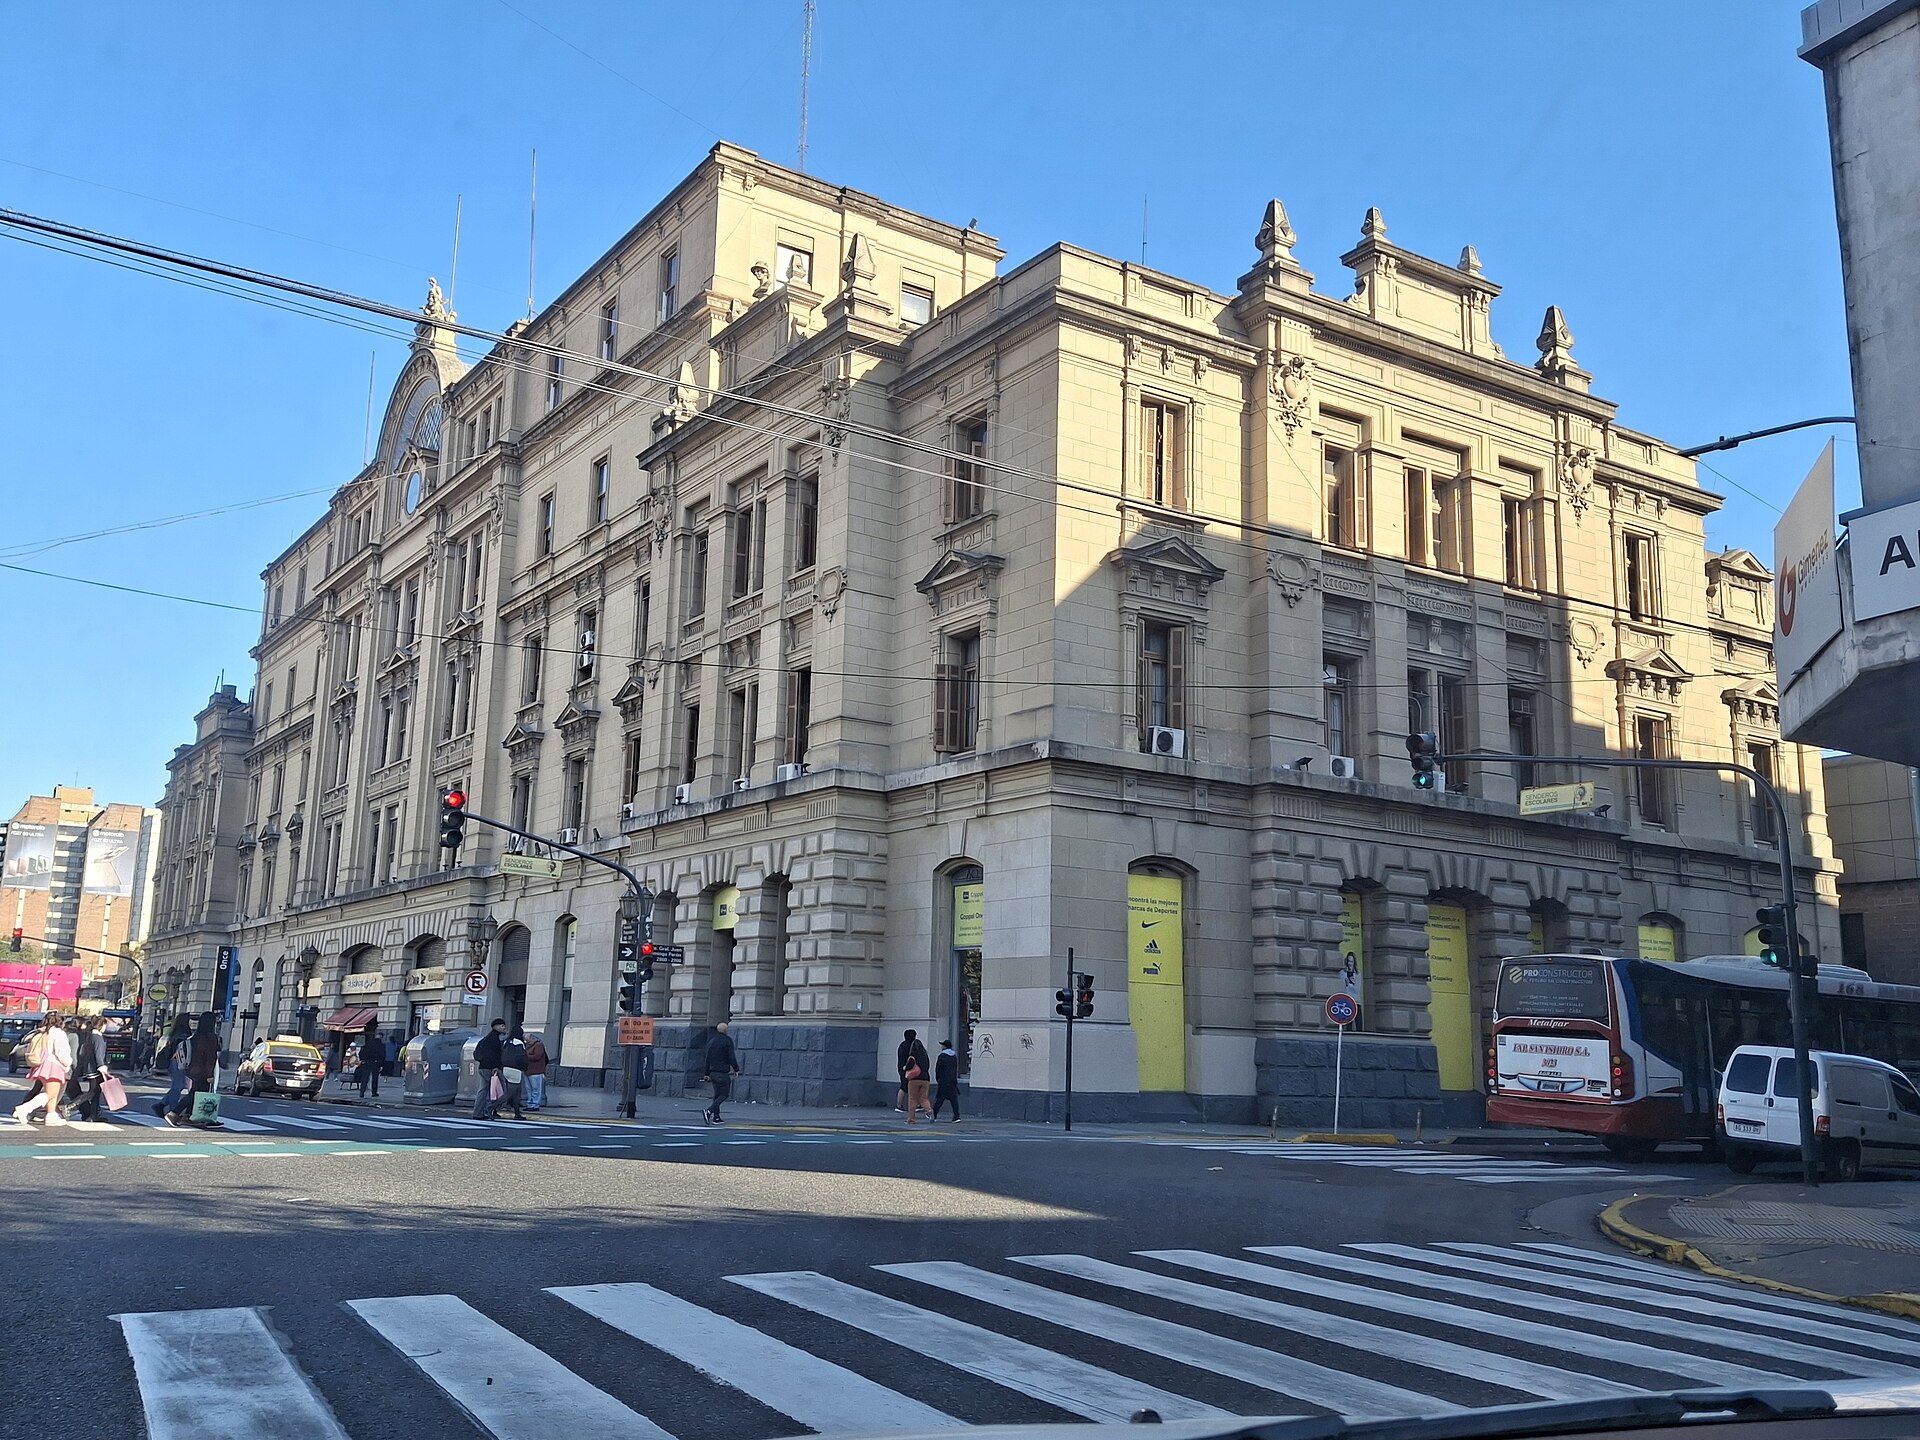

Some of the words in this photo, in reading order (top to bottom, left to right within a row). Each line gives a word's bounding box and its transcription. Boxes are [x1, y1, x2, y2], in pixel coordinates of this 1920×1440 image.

[1525, 791, 1558, 800] SENDEROS
[1525, 798, 1558, 806] ESCOLARES
[1154, 907, 1178, 915] Deportes
[219, 950, 229, 970] Once
[1523, 969, 1593, 978] PROCONSTRUCTOR
[1528, 1019, 1569, 1028] Metalpar
